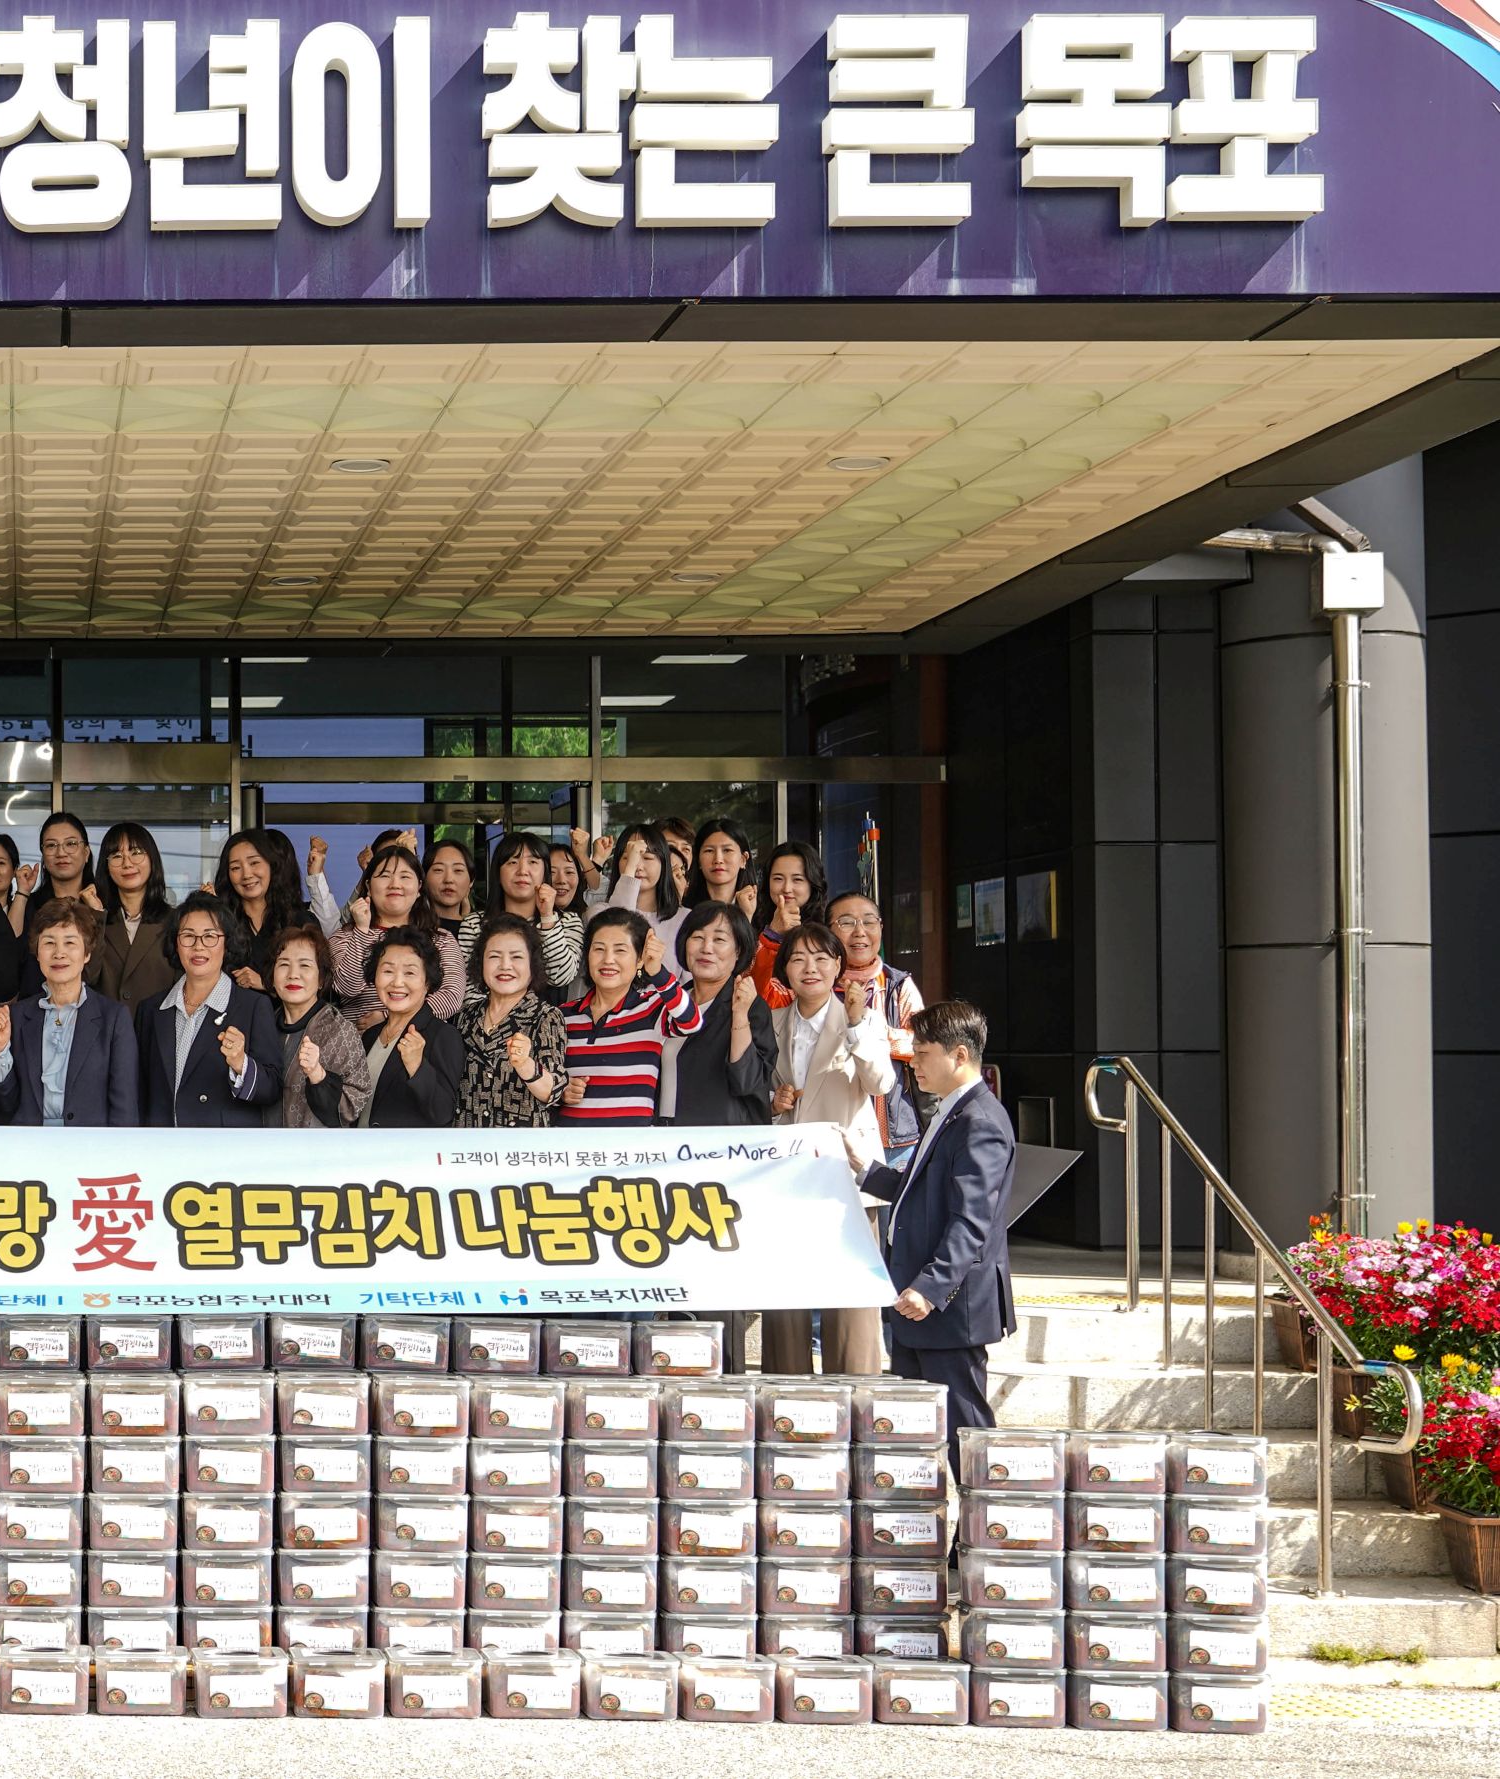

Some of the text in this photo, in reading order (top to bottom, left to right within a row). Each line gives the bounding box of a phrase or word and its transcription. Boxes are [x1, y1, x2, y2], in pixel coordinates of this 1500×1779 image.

[482, 12, 780, 228] 찾는
[821, 13, 976, 227] 큰
[1016, 12, 1325, 228] 목포
[451, 1151, 499, 1166] 고객이
[505, 1151, 569, 1167] 생각하지
[575, 1151, 608, 1167] 못한
[613, 1151, 629, 1166] 것
[635, 1151, 667, 1165] 까지
[677, 1144, 724, 1162] One
[728, 1143, 783, 1161] More
[73, 1173, 155, 1272] 愛
[163, 1179, 446, 1271] 열무김치
[452, 1174, 741, 1269] 나눔행사
[116, 1293, 332, 1308] 목포농협주부대학
[358, 1290, 466, 1308] 기탁단체
[538, 1286, 690, 1304] 목포복지재단
